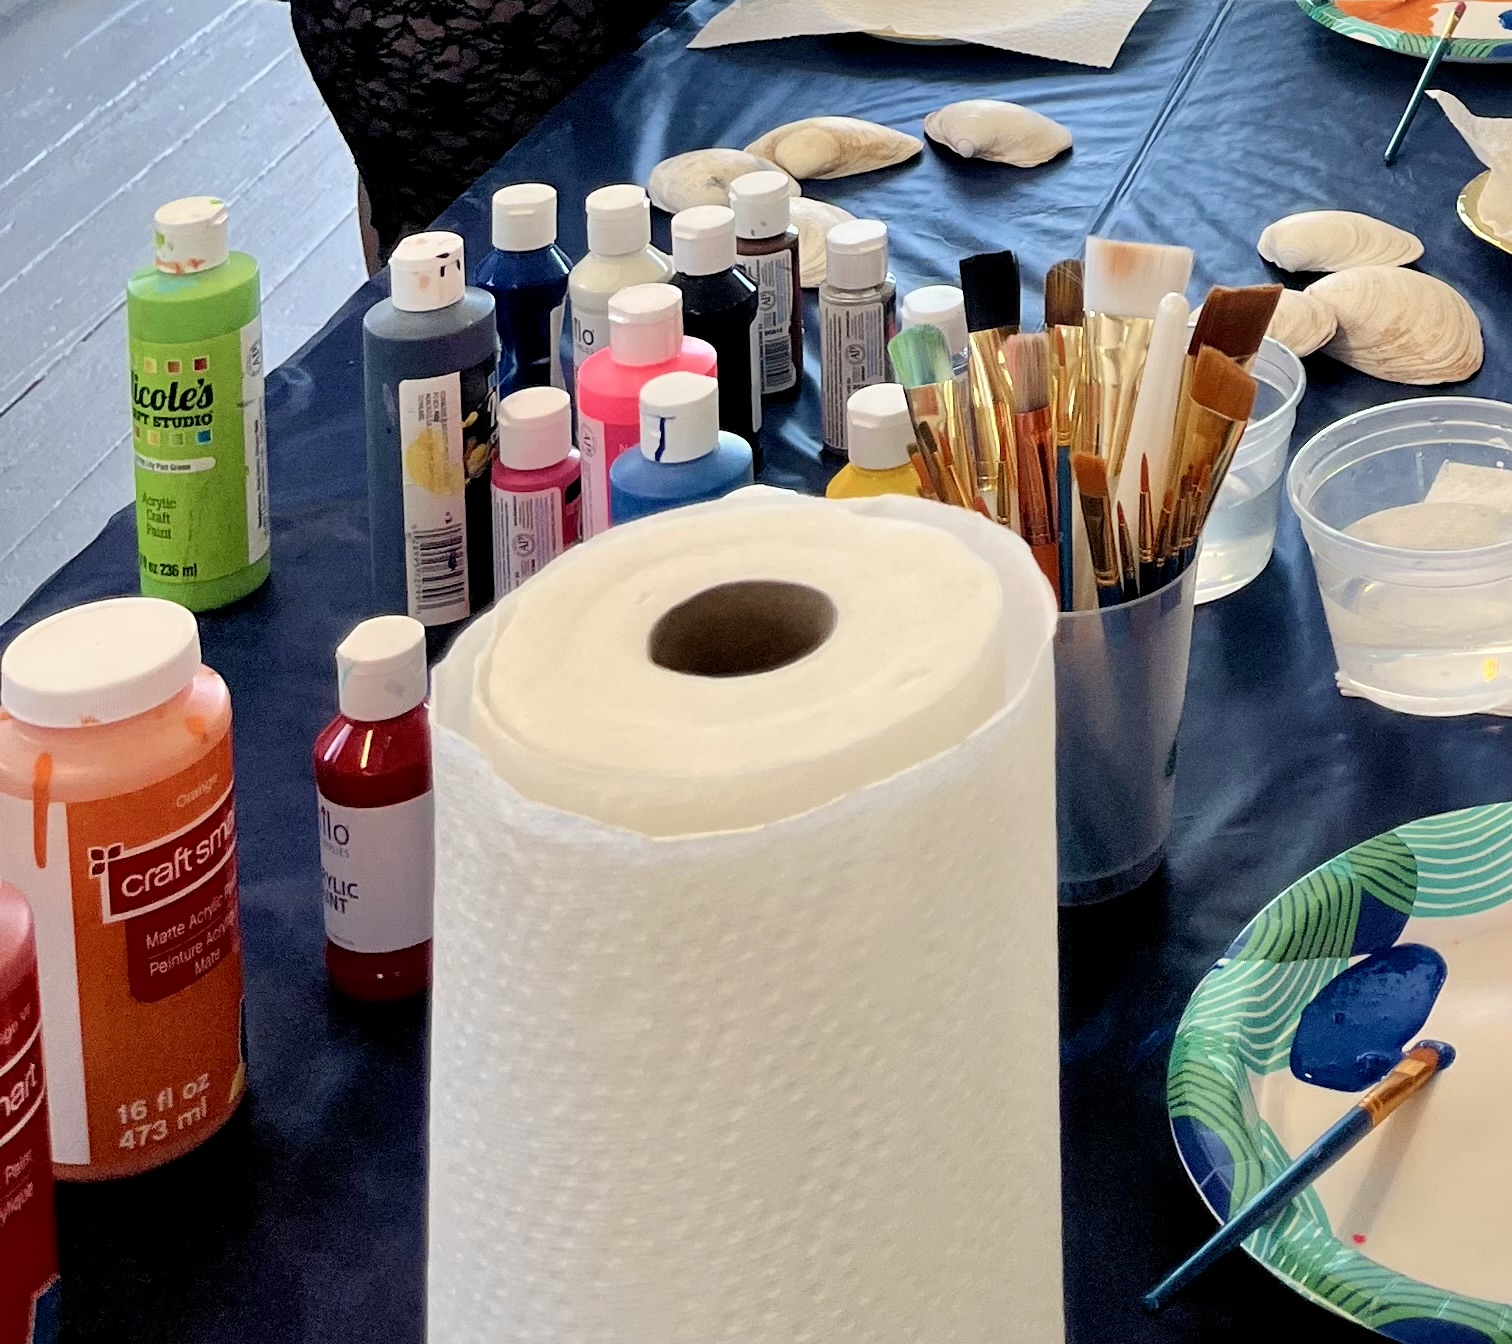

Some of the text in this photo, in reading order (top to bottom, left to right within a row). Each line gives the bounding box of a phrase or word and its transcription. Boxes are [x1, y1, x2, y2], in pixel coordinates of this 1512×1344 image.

[131, 370, 214, 412] icole's
[153, 414, 213, 429] STUDIO
[142, 492, 177, 510] Acrylic
[146, 508, 171, 524] Craft
[146, 522, 172, 540] Paint
[159, 563, 179, 578] 236
[182, 562, 198, 578] ml
[120, 845, 194, 899] craft
[195, 808, 236, 865] sma
[146, 923, 186, 951] Matte
[149, 941, 203, 977] Peinture
[117, 1072, 210, 1124] 16 fl oz
[118, 1095, 208, 1150] 473 ml
